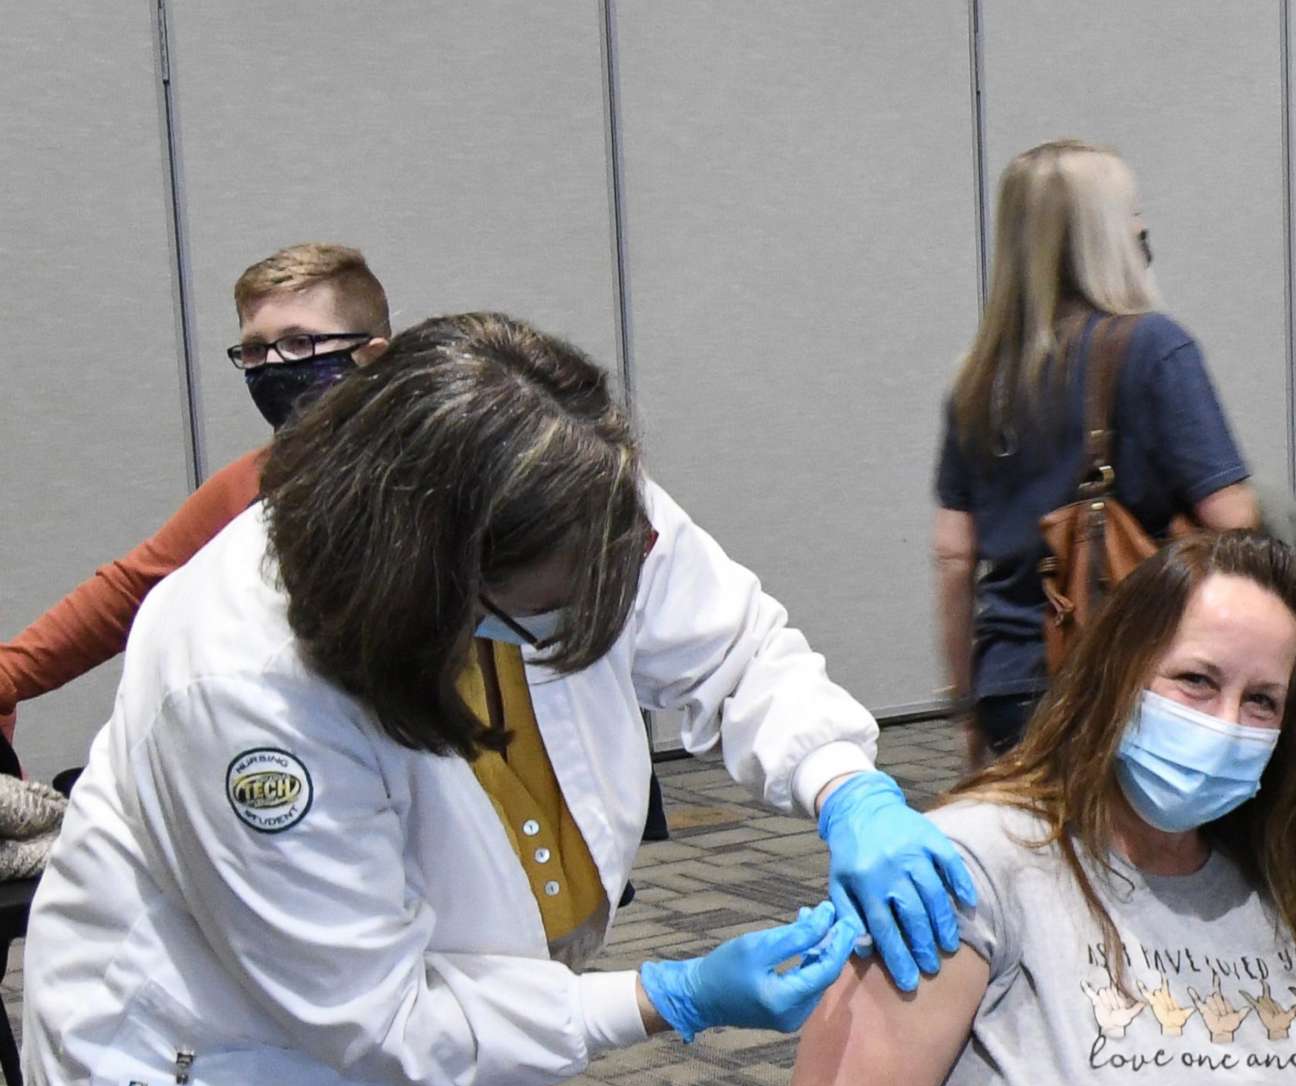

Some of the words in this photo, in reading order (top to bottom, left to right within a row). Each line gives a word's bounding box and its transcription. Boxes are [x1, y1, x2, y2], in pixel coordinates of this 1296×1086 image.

[236, 755, 288, 773] NURSING
[242, 776, 292, 802] TECH
[245, 807, 298, 825] STUDENT
[1089, 1034, 1174, 1072] love
[1180, 1051, 1240, 1071] one
